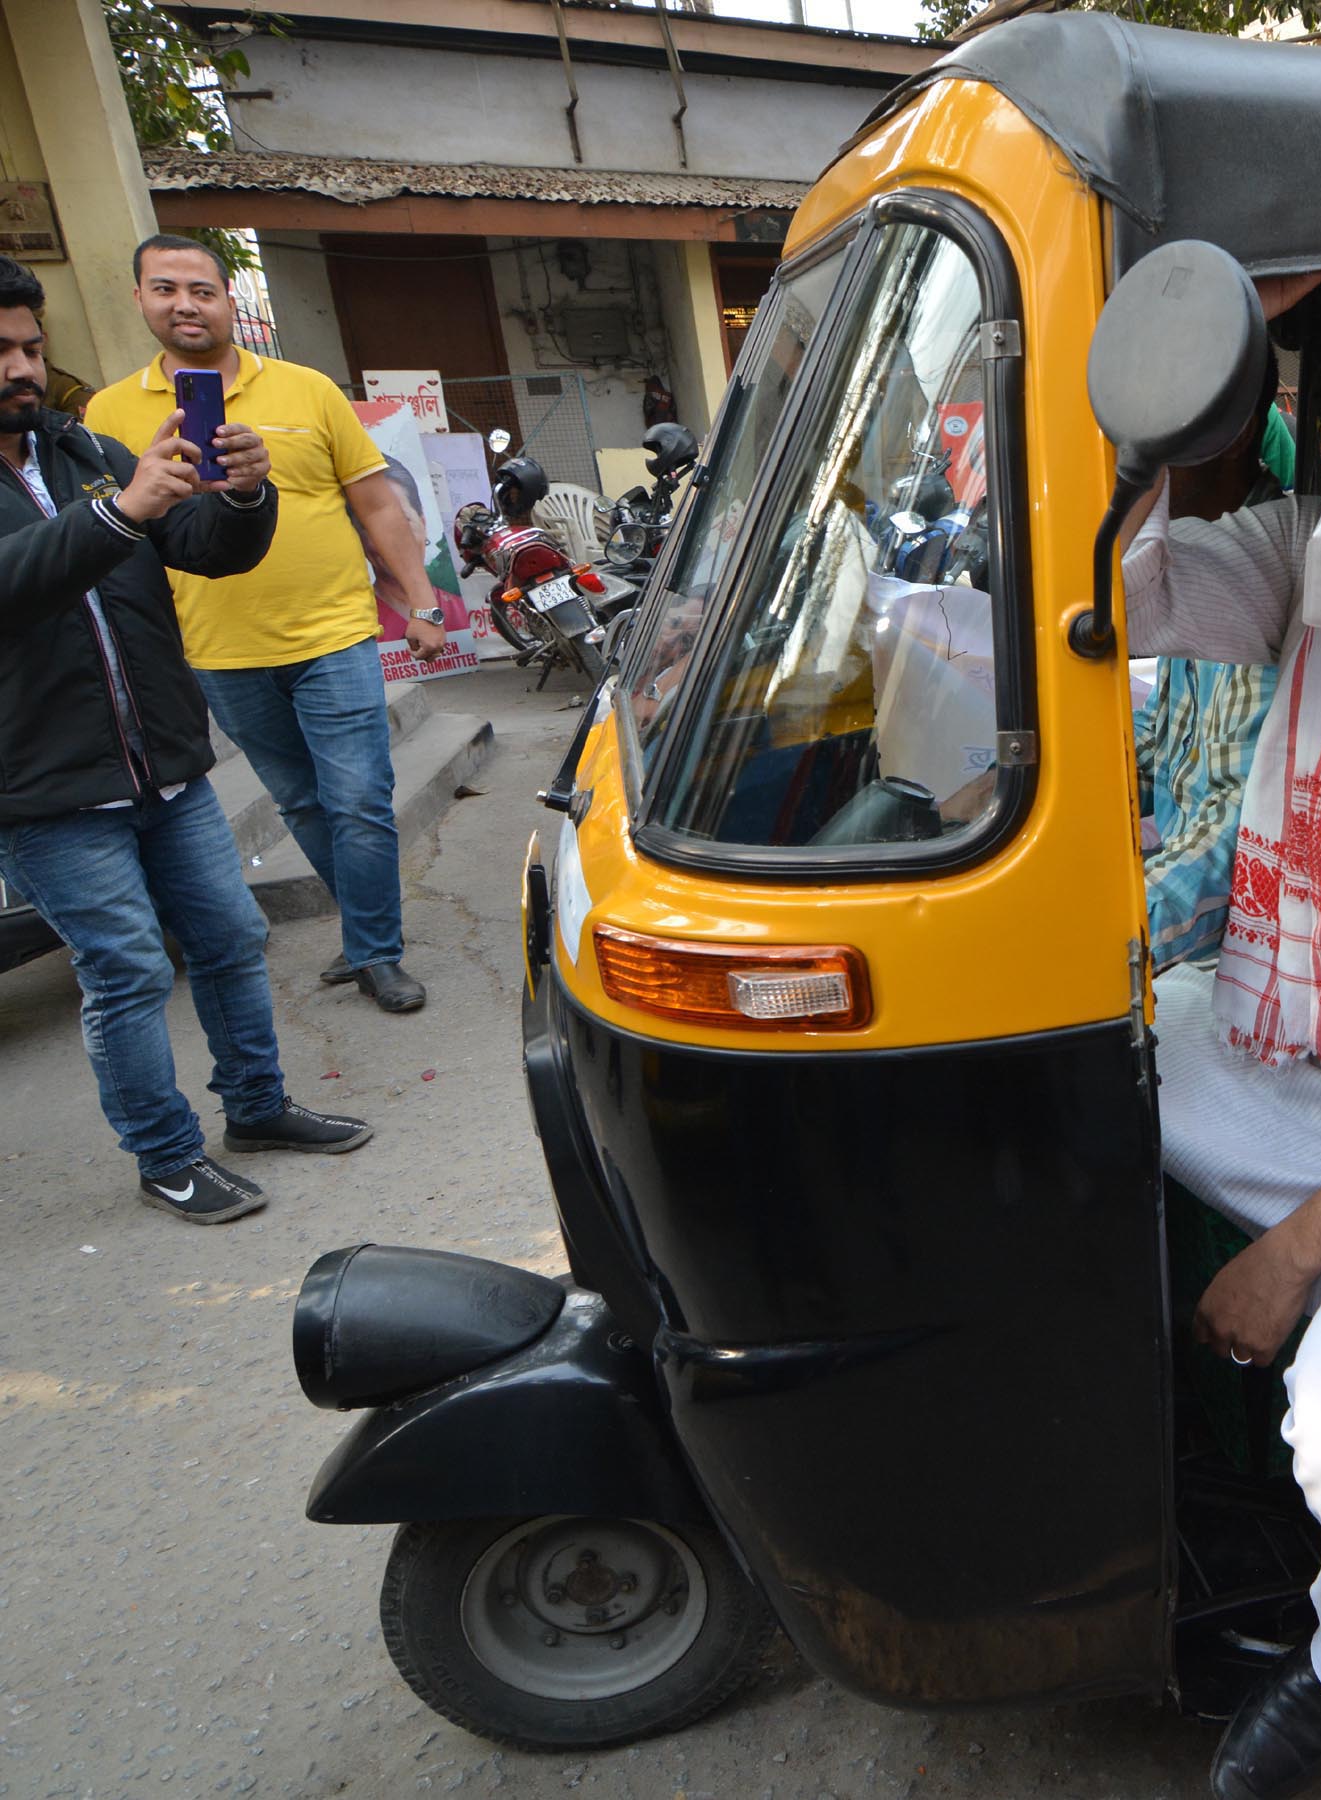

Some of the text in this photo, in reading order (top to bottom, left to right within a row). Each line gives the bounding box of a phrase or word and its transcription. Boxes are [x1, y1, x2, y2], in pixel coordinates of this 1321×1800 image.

[380, 649, 412, 667] SSAM
[383, 653, 478, 682] GRESS COMMITTEE
